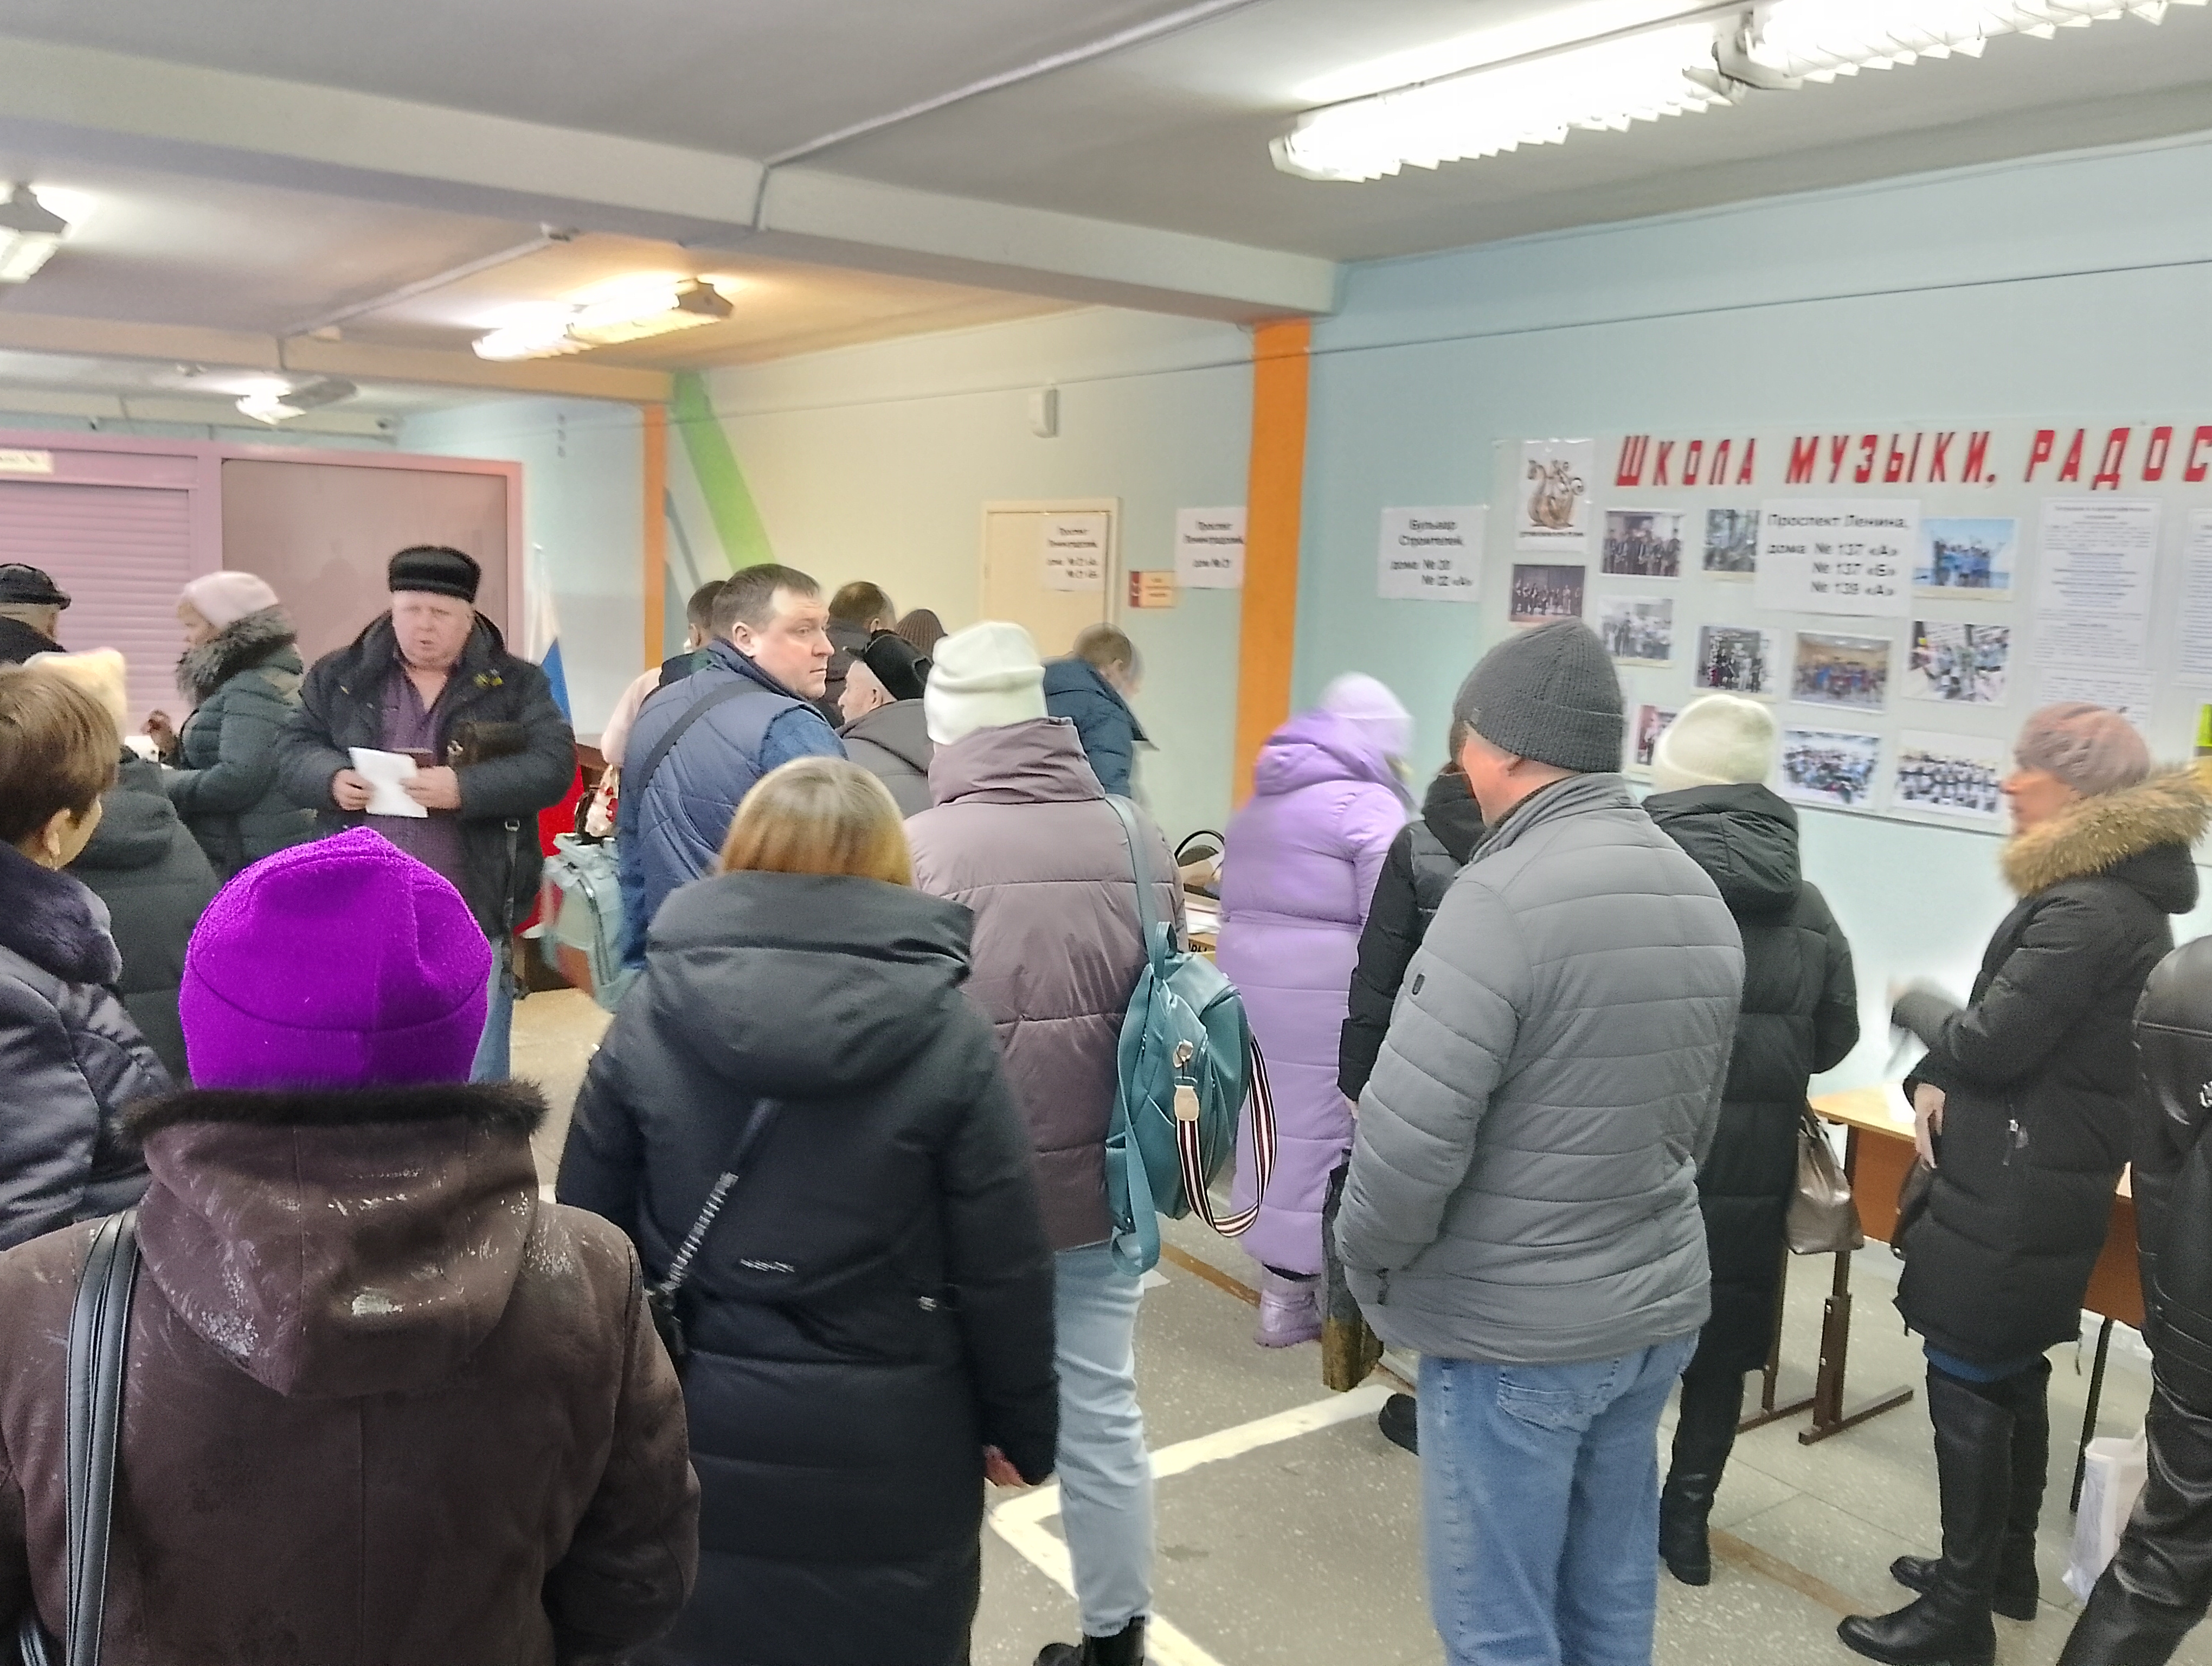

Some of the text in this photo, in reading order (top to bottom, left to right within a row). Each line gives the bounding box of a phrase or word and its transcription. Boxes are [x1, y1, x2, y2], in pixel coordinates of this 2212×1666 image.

[1614, 434, 1757, 486] ШКОЛА
[2023, 425, 2212, 491] РАДОС
[1767, 514, 1842, 528] Проспект
